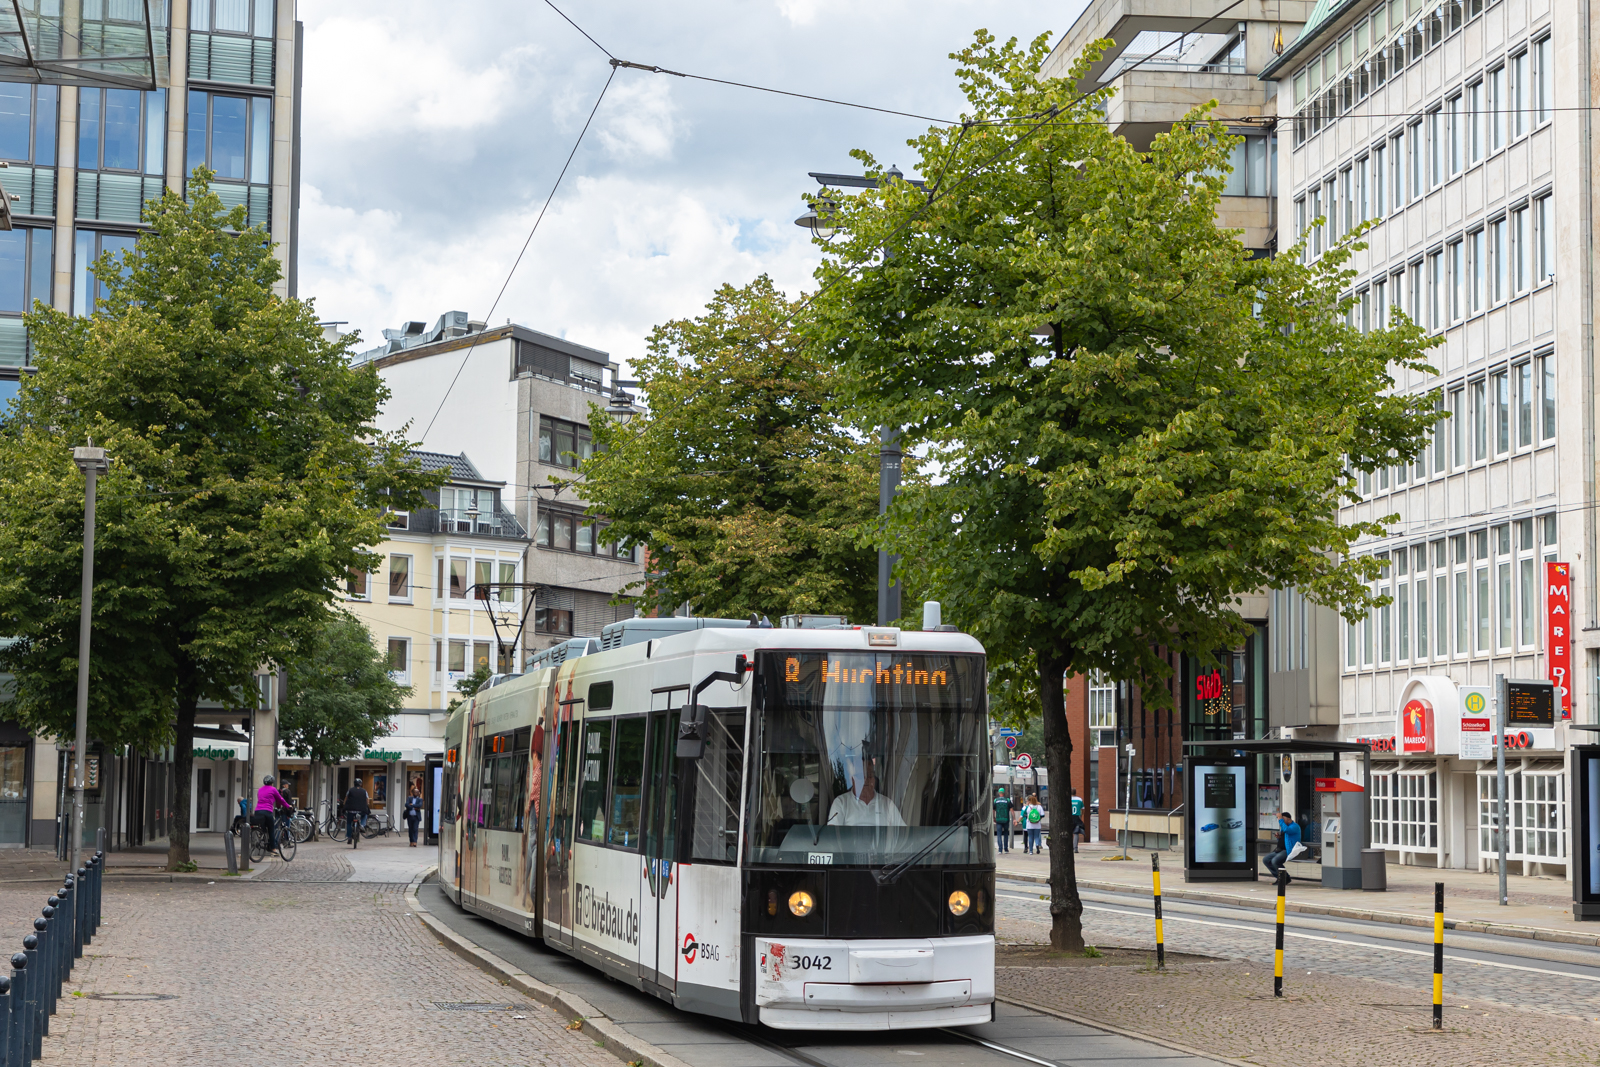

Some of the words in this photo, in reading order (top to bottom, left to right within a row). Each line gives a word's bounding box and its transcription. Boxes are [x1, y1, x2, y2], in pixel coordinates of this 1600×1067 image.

[1196, 669, 1222, 700] swb
[1404, 735, 1426, 744] MAREDO
[810, 854, 832, 865] 6017
[591, 887, 638, 947] brebau.de
[701, 943, 720, 961] BSAG
[791, 955, 832, 970] 3042
